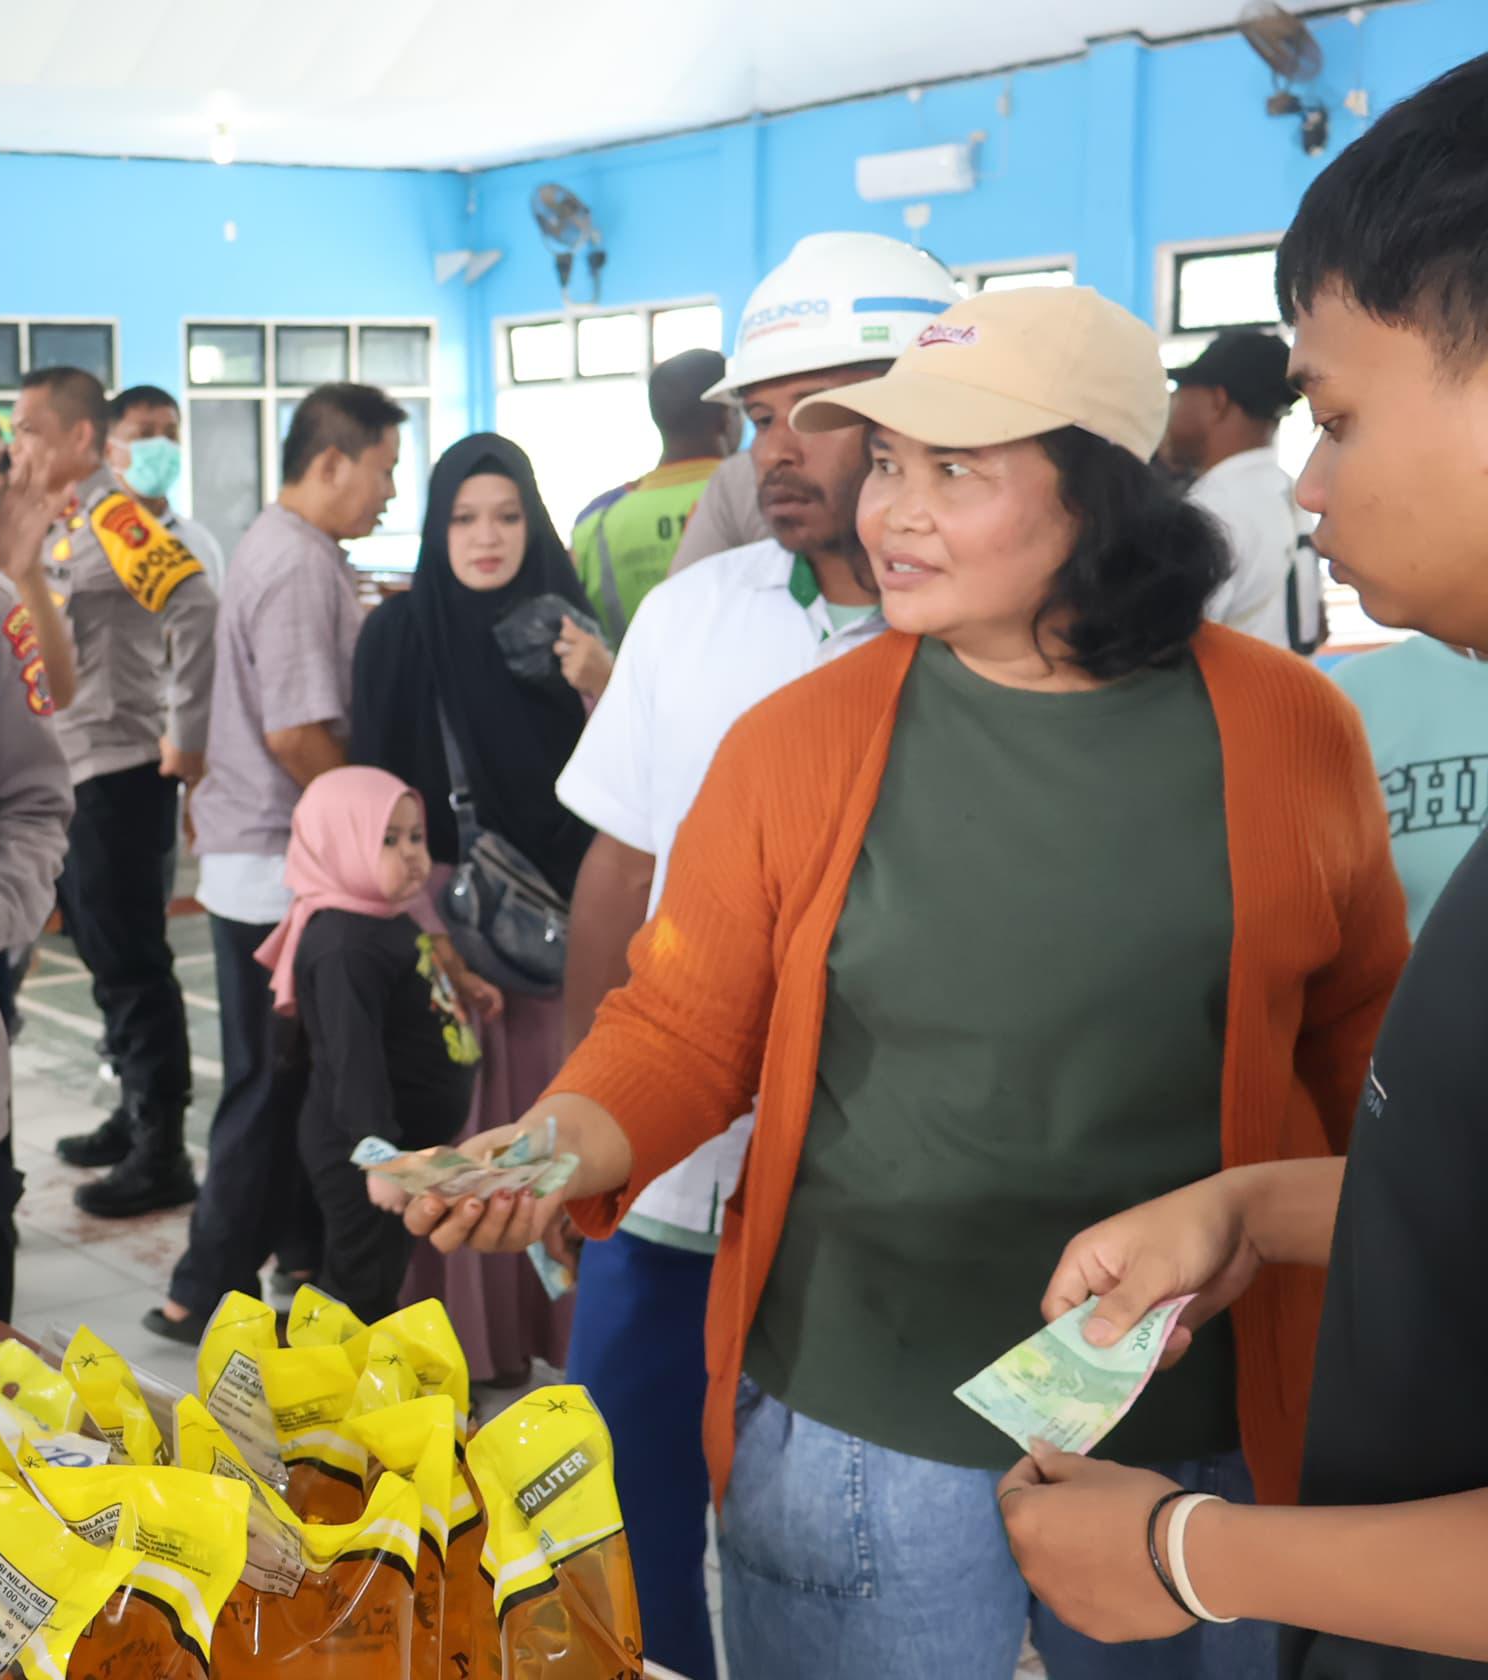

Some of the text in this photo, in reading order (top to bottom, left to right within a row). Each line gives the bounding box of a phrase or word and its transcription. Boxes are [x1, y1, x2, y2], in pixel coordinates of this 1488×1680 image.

[78, 1508, 121, 1533] NILAI GIZ
[2, 1585, 18, 1602] 100
[16, 1601, 30, 1613] ml
[6, 1571, 30, 1596] NILAI
[29, 1592, 49, 1609] GIZI
